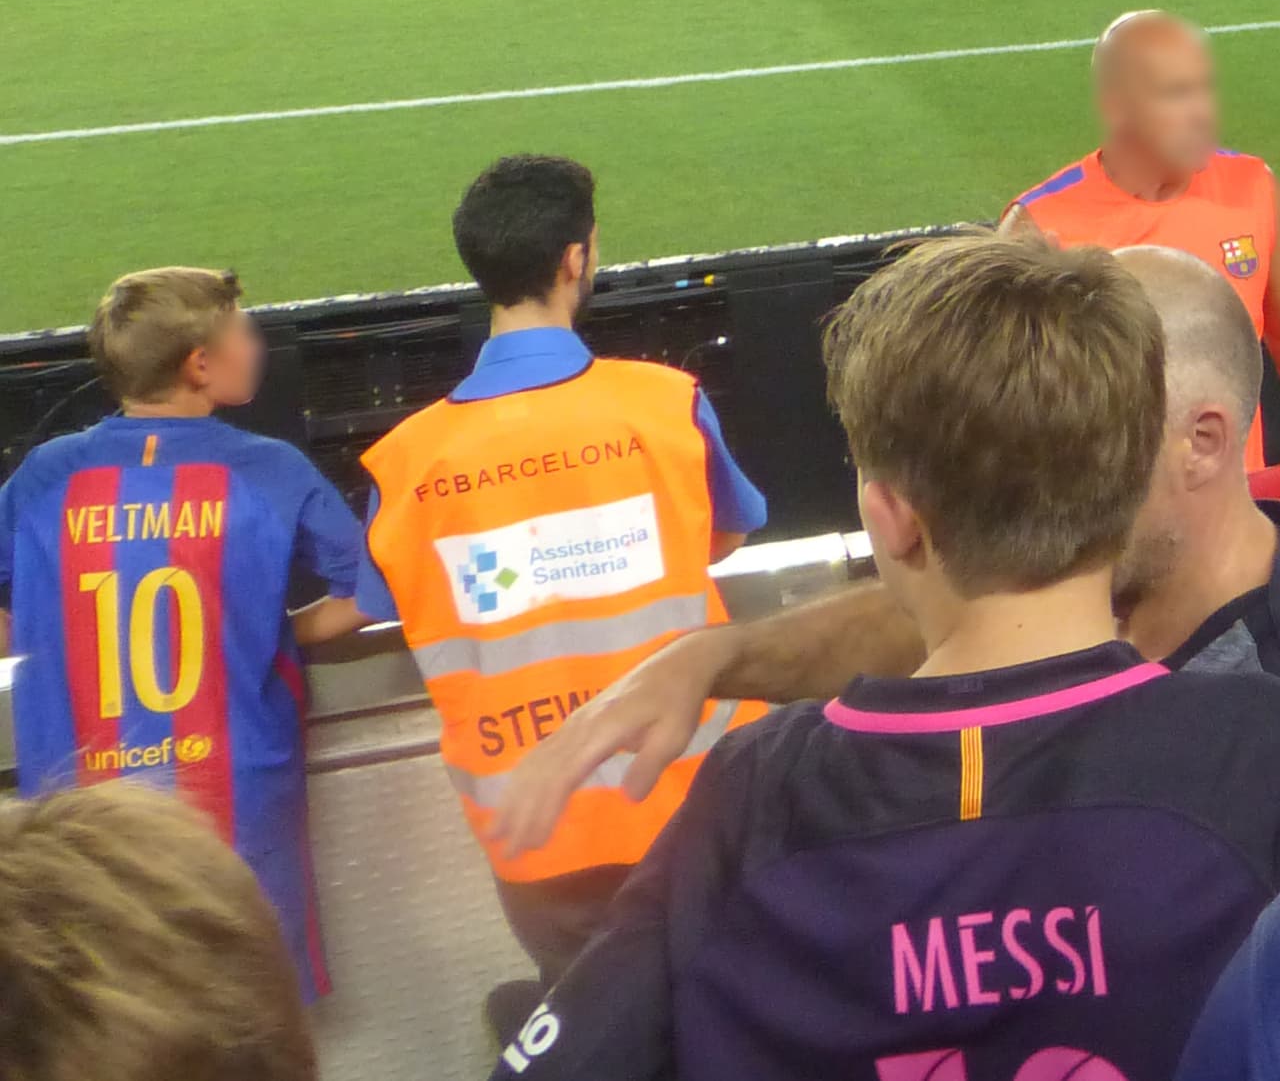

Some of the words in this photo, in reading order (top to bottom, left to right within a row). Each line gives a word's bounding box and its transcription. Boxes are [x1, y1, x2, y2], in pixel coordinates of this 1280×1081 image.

[414, 435, 644, 502] FCBARCELONA
[66, 500, 223, 545] VELTMAN
[533, 556, 630, 585] Sanitaria
[79, 567, 204, 719] 10
[85, 736, 173, 771] unicef
[478, 688, 602, 757] STEW
[891, 905, 1108, 1014] MESSI
